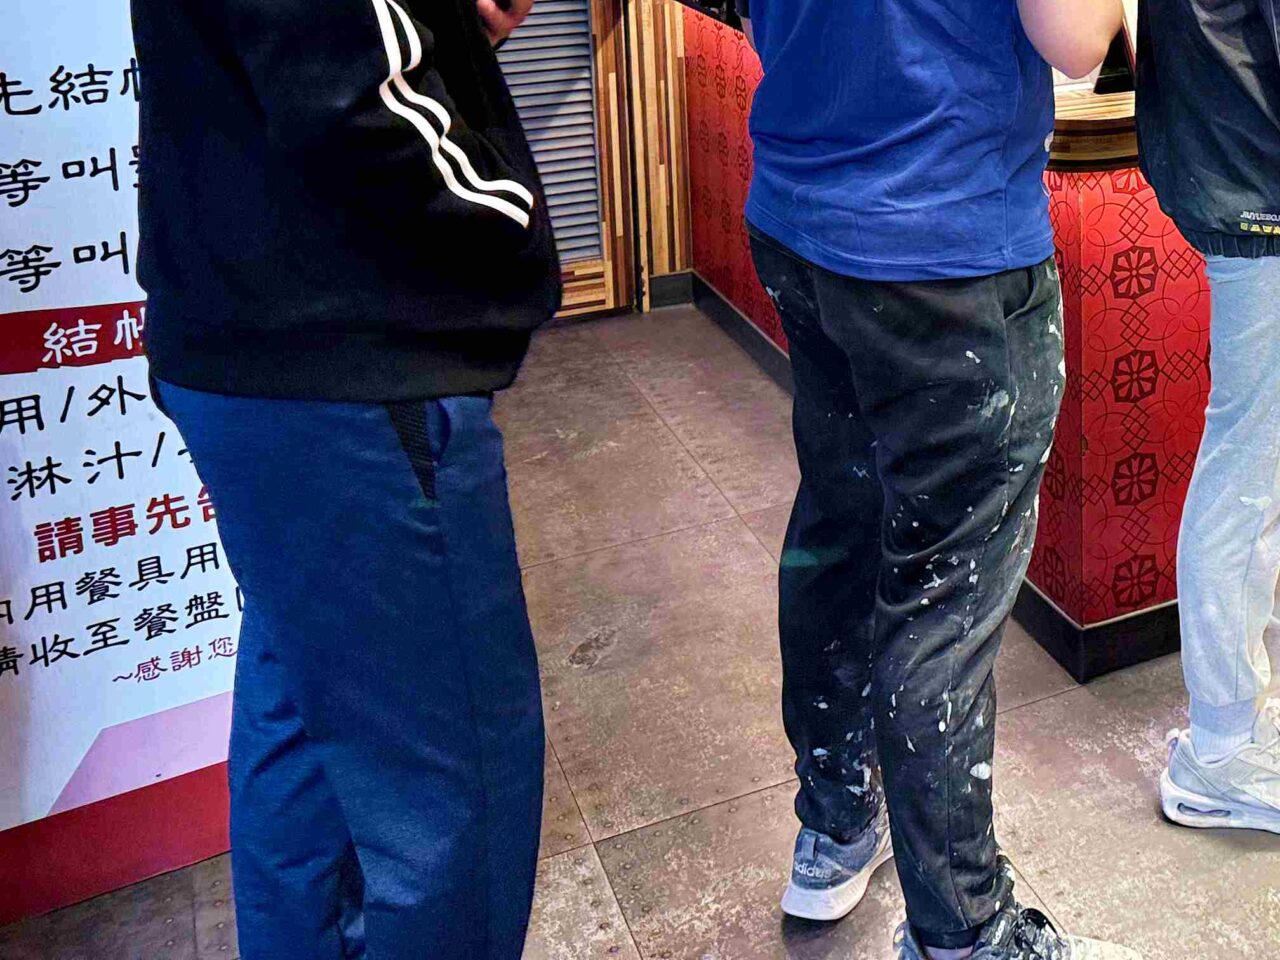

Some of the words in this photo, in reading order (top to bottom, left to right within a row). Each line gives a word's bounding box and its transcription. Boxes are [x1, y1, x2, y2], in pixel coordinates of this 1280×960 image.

[0, 145, 140, 208] 等叫
[0, 231, 130, 294] 等叫
[7, 431, 190, 502] 淋汁/
